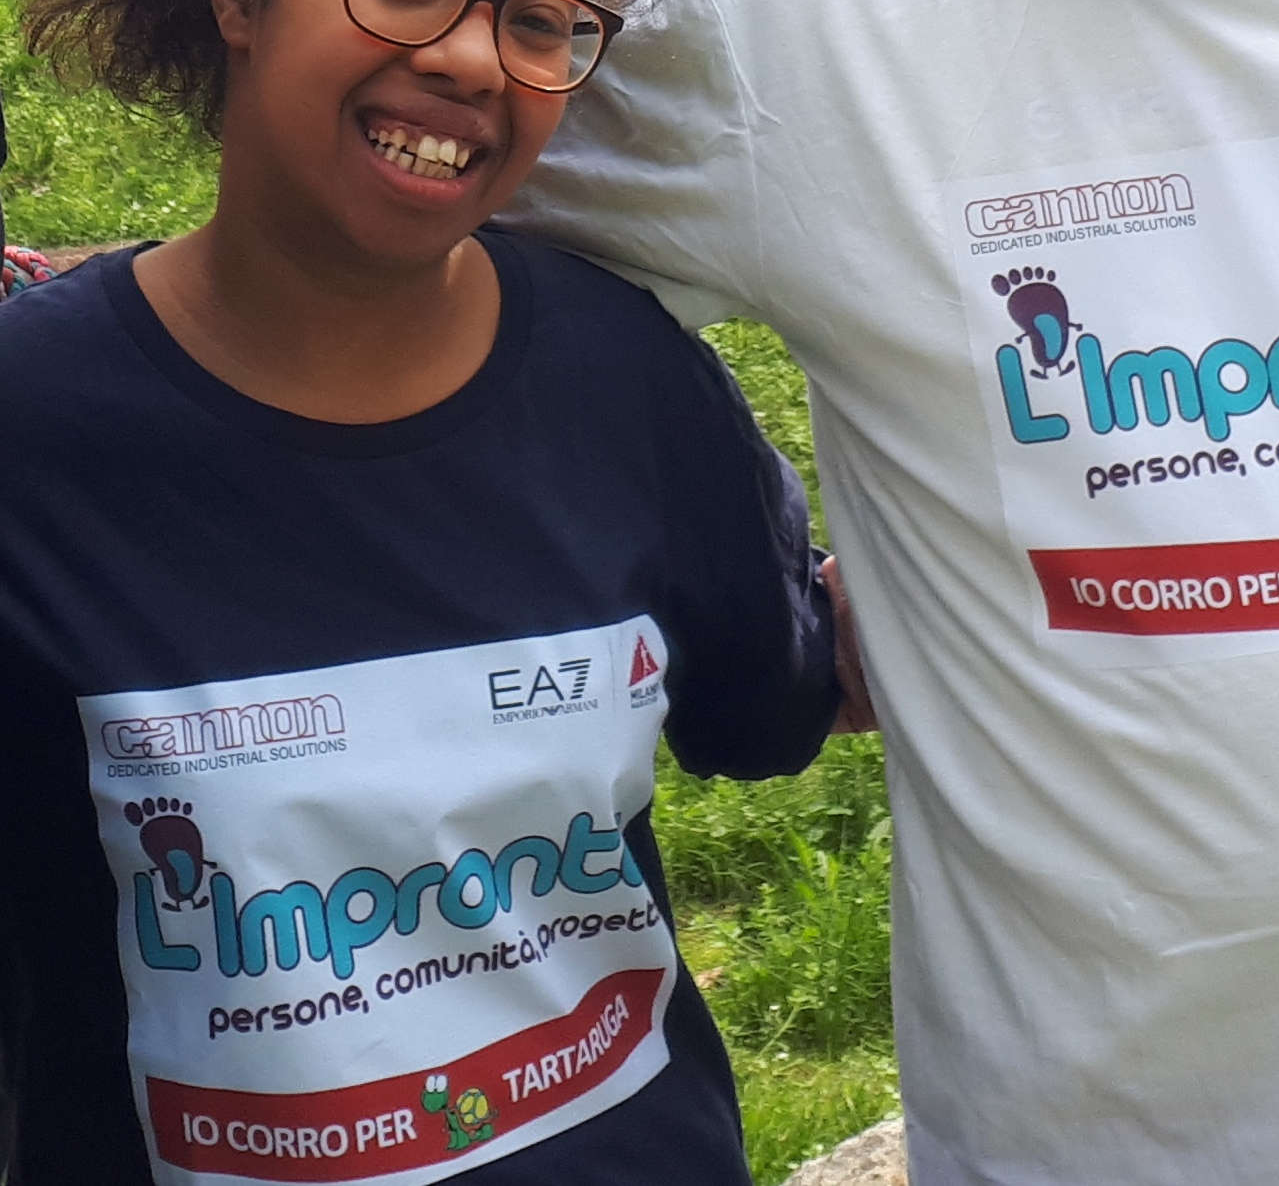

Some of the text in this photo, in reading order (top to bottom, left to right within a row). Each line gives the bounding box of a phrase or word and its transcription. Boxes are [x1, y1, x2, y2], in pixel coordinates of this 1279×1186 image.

[966, 174, 1194, 238] cannon
[970, 214, 1197, 255] DEDICATED INDUSTRIAL SOLUTIONS
[1086, 445, 1247, 498] persone,
[1070, 576, 1107, 607] IO
[1111, 576, 1232, 611] CORRO
[489, 658, 591, 710] EA7
[101, 694, 346, 759] cannon
[107, 738, 347, 778] DEDICATED INDUSTRIAL SOLUTIONS
[208, 900, 660, 1040] persone, comunità, progett
[182, 993, 630, 1158] IO CORRO PER TARTARUGA
